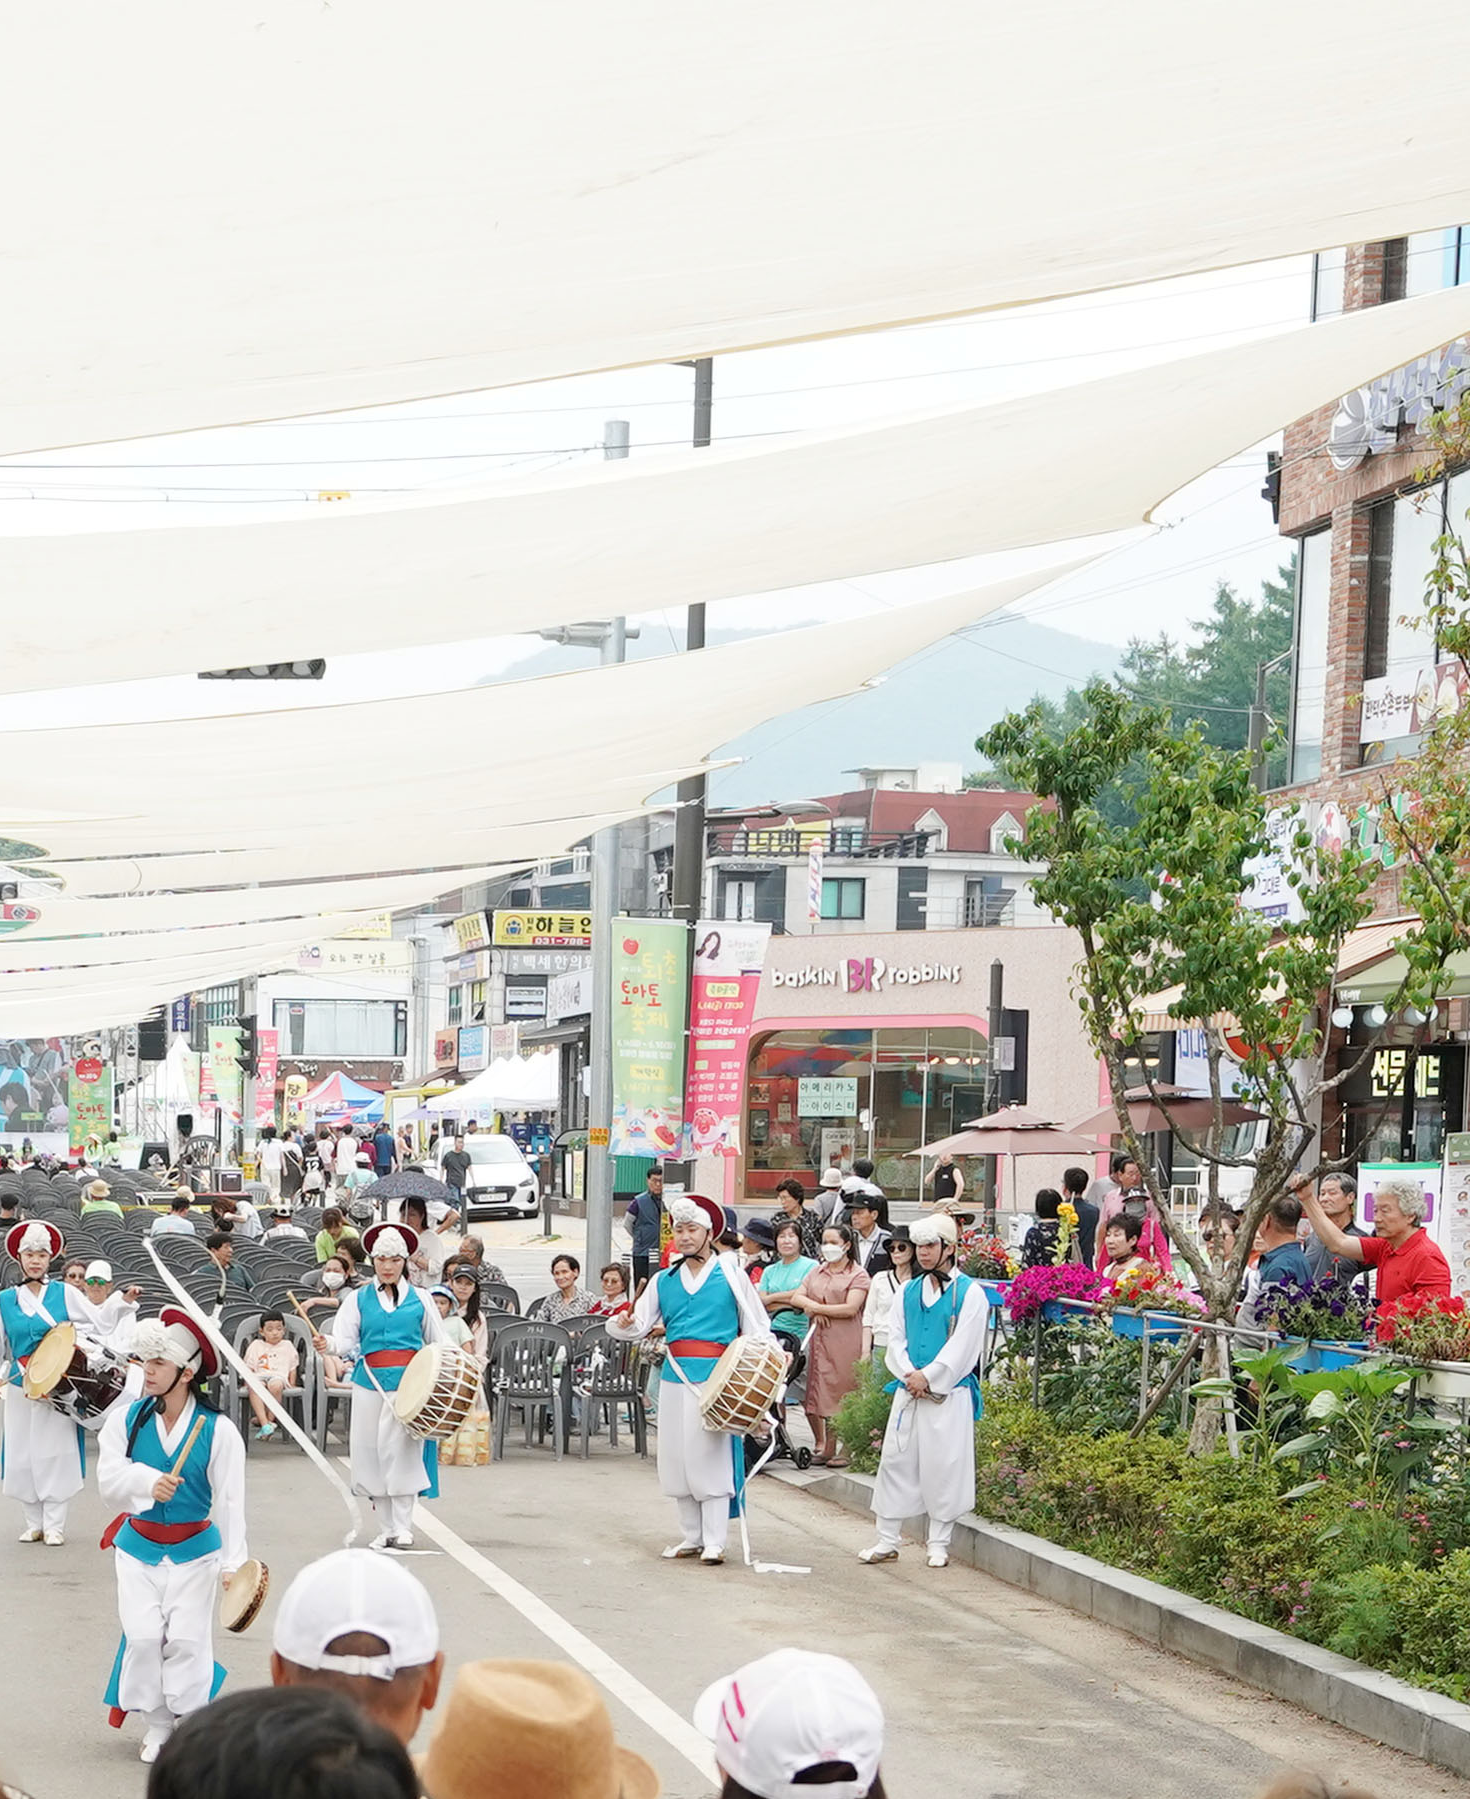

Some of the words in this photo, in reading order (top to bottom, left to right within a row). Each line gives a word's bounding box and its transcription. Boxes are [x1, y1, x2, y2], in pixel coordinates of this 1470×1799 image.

[771, 964, 837, 988] baskin
[839, 957, 886, 993] BR
[888, 962, 962, 985] robbins
[621, 979, 662, 1007] 토마토
[800, 1081, 856, 1094] 아메리카노
[1370, 1049, 1406, 1097] 선물
